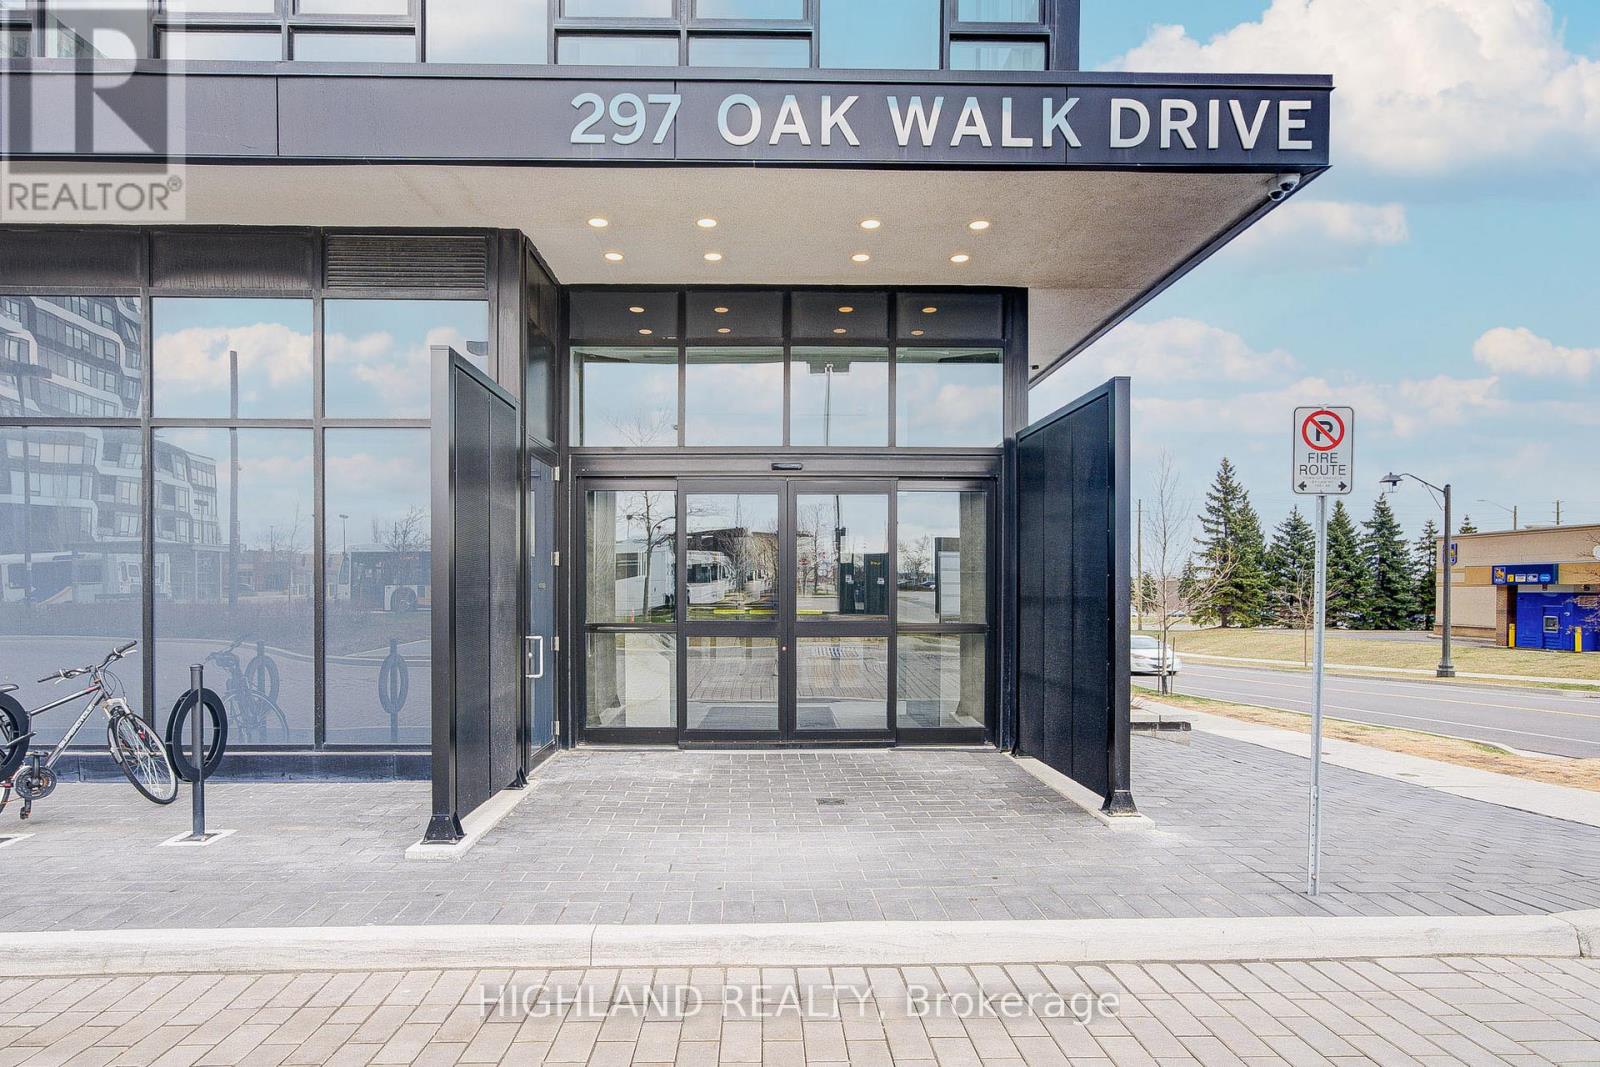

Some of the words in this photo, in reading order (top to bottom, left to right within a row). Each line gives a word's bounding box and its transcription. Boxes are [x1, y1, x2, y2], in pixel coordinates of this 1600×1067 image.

[570, 92, 682, 145] 297
[717, 93, 860, 147] OAK
[886, 95, 1082, 148] WALK
[1109, 98, 1313, 151] DRIVE
[1308, 452, 1339, 464] FIRE
[1299, 464, 1347, 476] ROUTE
